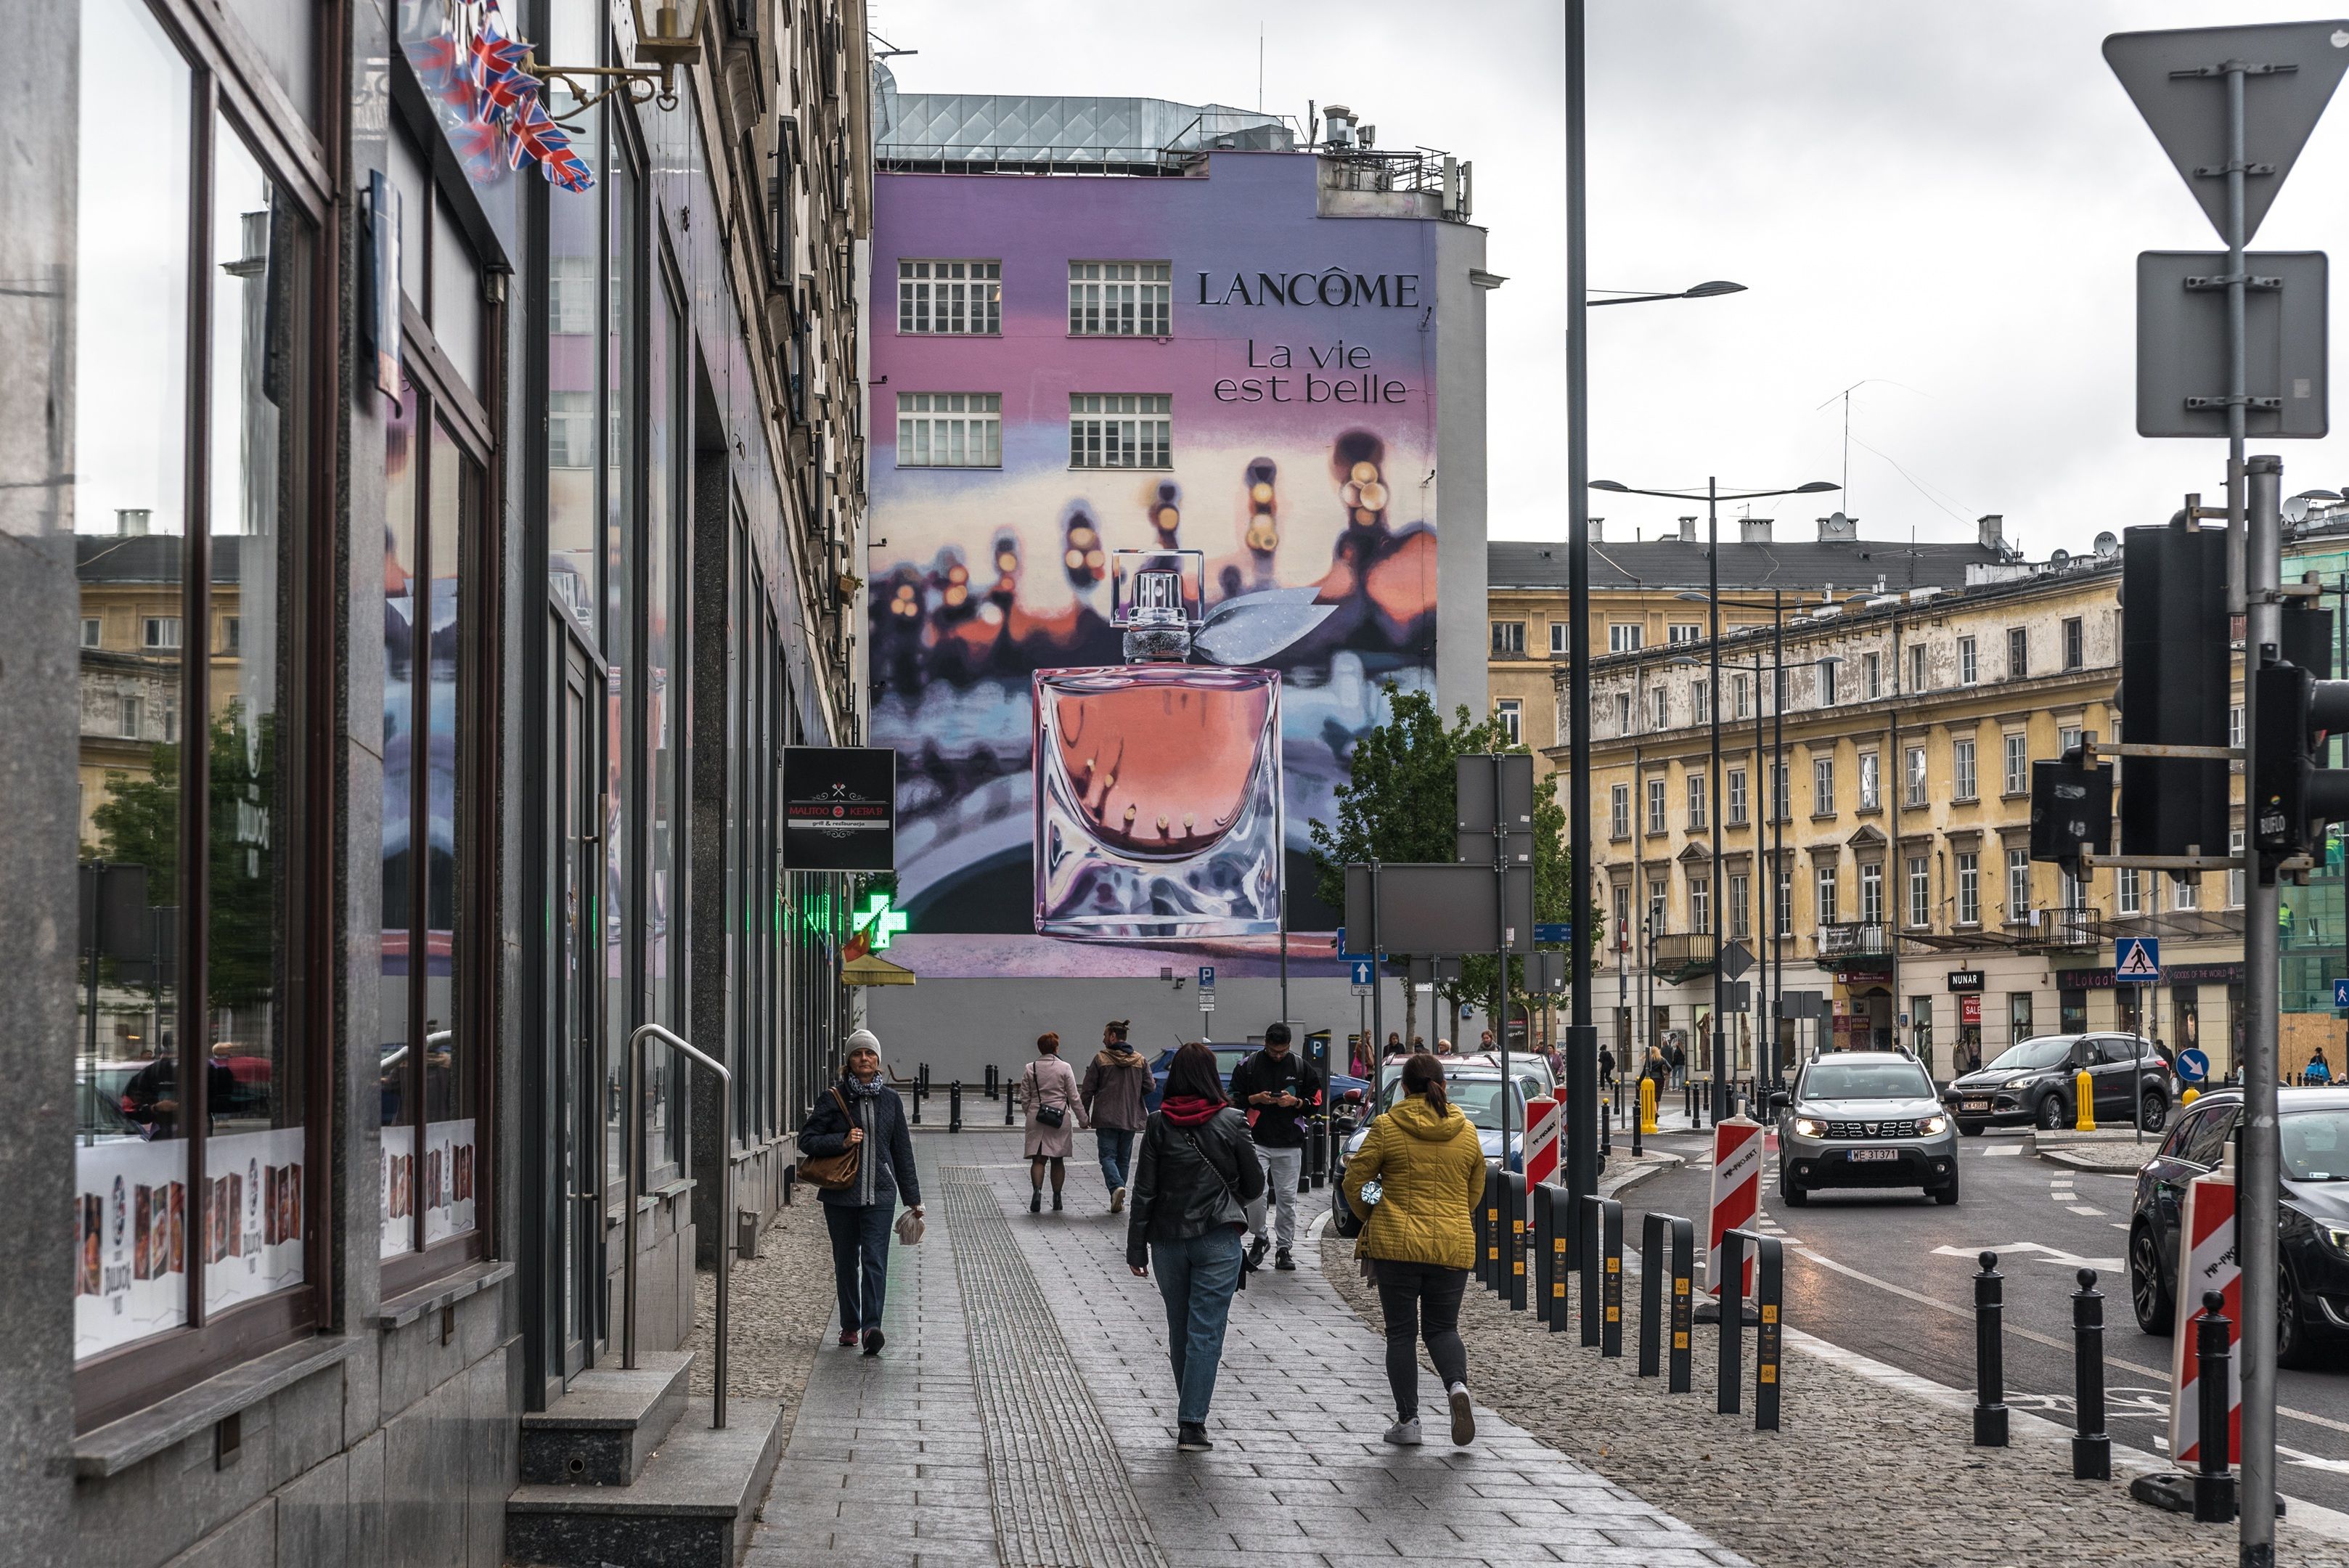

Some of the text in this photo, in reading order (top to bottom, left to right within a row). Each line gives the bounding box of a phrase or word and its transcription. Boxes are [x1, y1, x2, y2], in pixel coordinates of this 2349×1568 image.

[1197, 266, 1418, 307] LANCÔME
[1249, 340, 1370, 369] La vie
[1214, 373, 1405, 403] est belle
[790, 807, 883, 816] MALITOO KEBAB
[1203, 968, 1212, 981] P
[1953, 975, 1977, 984] NUNAR
[2174, 971, 2190, 979] GOODS
[2191, 970, 2198, 979] OF
[2208, 969, 2227, 978] WORLD
[1966, 1005, 1981, 1015] SALE
[1313, 1041, 1322, 1054] P
[1852, 1149, 1895, 1159] WE 3T371
[1723, 1148, 1757, 1179] MP-PROJEKT
